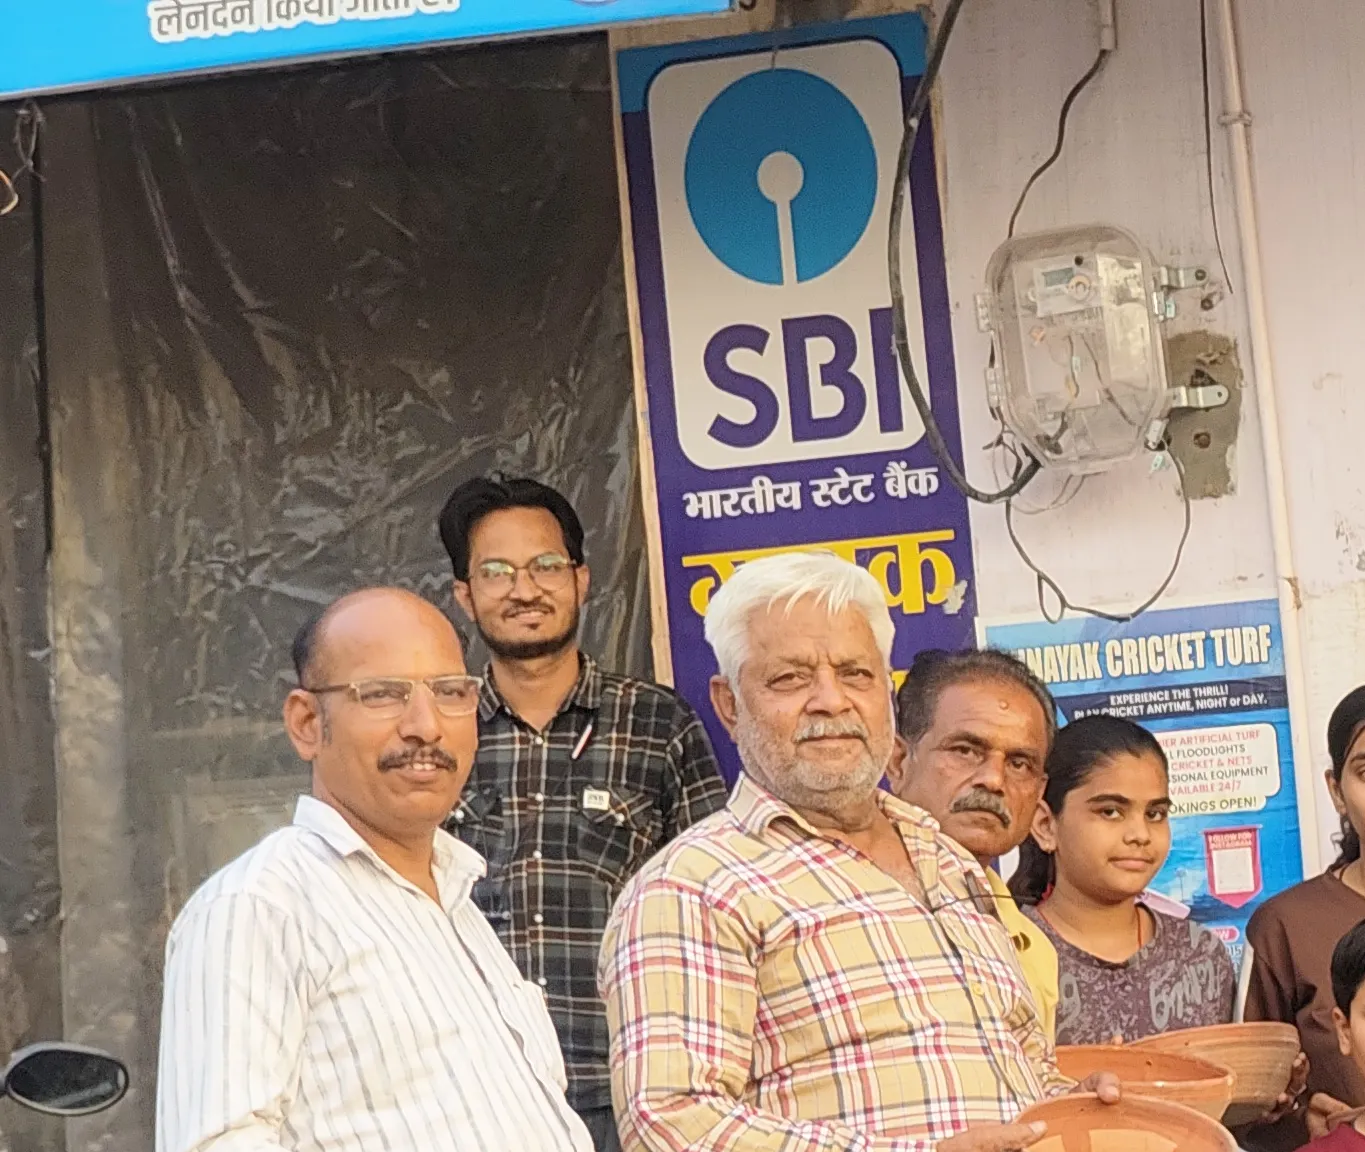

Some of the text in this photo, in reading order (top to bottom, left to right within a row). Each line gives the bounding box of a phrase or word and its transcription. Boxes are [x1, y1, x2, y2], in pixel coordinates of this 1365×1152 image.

[703, 307, 904, 449] SBI
[682, 461, 939, 520] भारतीय स्टेट बैंक
[1017, 624, 1272, 684] NAYAK CRICKET TURF
[1109, 684, 1229, 706] EXPERIENCE THE THRILL!
[1146, 699, 1195, 716] ANYTIME,
[1195, 696, 1228, 712] NIGHT
[1242, 693, 1268, 706] DAY.
[1180, 733, 1234, 747] ARTIFICIAL
[1236, 729, 1261, 741] TURF
[1176, 743, 1246, 760] FLOODLIGHTS
[1170, 759, 1214, 772] CRICKET
[1227, 755, 1253, 766] NETS
[1210, 765, 1269, 781] EQUIPMENT
[1170, 780, 1242, 797] VAILABLE 24/7
[1168, 795, 1258, 815] OKINGS OPEN!
